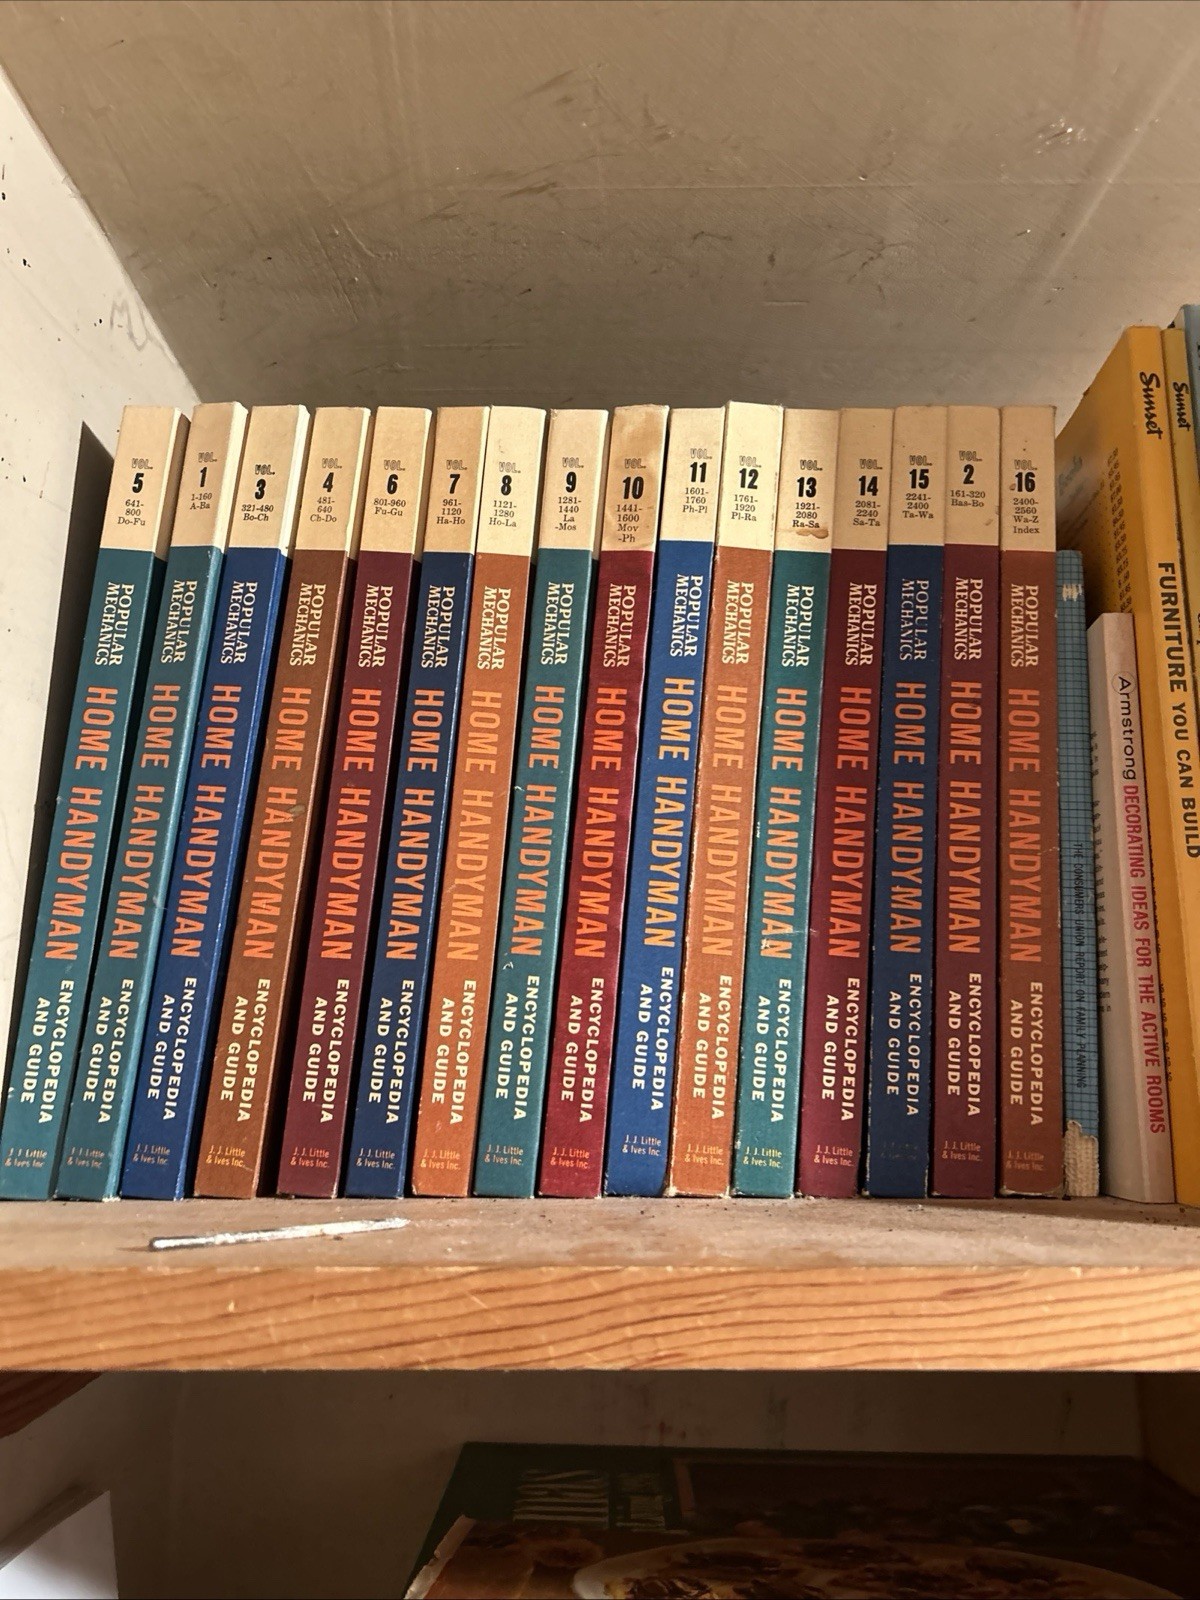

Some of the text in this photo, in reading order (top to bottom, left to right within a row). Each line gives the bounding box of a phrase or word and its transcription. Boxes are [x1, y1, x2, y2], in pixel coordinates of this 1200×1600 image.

[1139, 371, 1163, 439] Sunset
[1172, 381, 1191, 431] Sunset
[132, 458, 153, 469] VOL.
[198, 453, 217, 462] VOL.
[322, 458, 342, 468] VOL.
[562, 457, 584, 468] VOL.
[624, 458, 646, 469] VOL.
[690, 448, 712, 459] VOL.
[739, 456, 761, 468] VOL.
[859, 459, 882, 469] VOL.
[909, 455, 932, 466] VOL.
[959, 451, 982, 462] VOL.
[1014, 459, 1037, 470] VOL.
[255, 465, 275, 475] VOL.
[384, 460, 405, 471] VOL.
[446, 460, 467, 470] VOL.
[499, 462, 521, 473] VOL.
[690, 462, 707, 482] 11
[800, 460, 823, 471] VOL.
[963, 464, 974, 484] 2
[132, 473, 144, 493] 5
[200, 467, 207, 487] 1
[323, 472, 334, 492] 4
[387, 474, 398, 494] 6
[449, 474, 460, 494] 7
[501, 475, 512, 495] 8
[566, 472, 577, 492] 9
[623, 476, 644, 499] 10
[739, 468, 759, 489] 12
[797, 477, 817, 497] 13
[859, 476, 878, 496] 14
[909, 469, 929, 489] 15
[1015, 472, 1035, 492] 16
[255, 479, 266, 499] 3
[735, 504, 755, 512] 1920
[907, 502, 929, 510] 2400
[617, 514, 639, 522] 1600
[618, 524, 639, 532] Mov
[1013, 526, 1040, 534] Index
[95, 582, 120, 666] MECHANICS
[109, 584, 135, 665] POPULAR
[358, 585, 379, 667] MECHANICS
[371, 586, 392, 667] POPULAR
[670, 574, 689, 657] MECHANICS
[684, 576, 703, 656] POPULAR
[782, 584, 801, 667] MECHANICS
[795, 585, 814, 667] POPULAR
[954, 577, 970, 660] MECHANICS
[968, 579, 983, 661] POPULAR
[478, 587, 497, 670] MECHANICS
[491, 588, 511, 670] POPULAR
[1158, 562, 1200, 858] FURNITURE YOU CAN BUILD
[1118, 675, 1136, 780] Armstrong
[45, 686, 118, 960] HOME HANDYMAN
[575, 687, 627, 959] HOME HANDYMAN
[644, 678, 695, 947] HOME HANDYMAN
[760, 687, 807, 959] HOME HANDYMAN
[948, 681, 981, 953] HOME HANDYMAN
[320, 689, 381, 960] HOME HANDYMAN
[447, 691, 501, 960] HOME HANDYMAN
[1073, 843, 1083, 858] THE
[1073, 863, 1085, 914] CONSUMERS
[1075, 919, 1085, 947] UNION
[1123, 785, 1165, 1133] DECORATING IDEAS FOR THE ACTIVE ROOMS
[632, 984, 651, 1089] AND GUIDE
[650, 967, 673, 1110] ENCYCLOPEDIA
[948, 991, 962, 1096] AND GUIDE
[967, 973, 981, 1117] ENCYCLOPEDIA
[22, 998, 49, 1103] AND GUIDE
[38, 979, 74, 1123] ENCYCLOPEDIA
[302, 998, 327, 1102] AND GUIDE
[320, 979, 348, 1123] ENCYCLOPEDIA
[432, 999, 453, 1103] AND GUIDE
[450, 981, 475, 1124] ENCYCLOPEDIA
[752, 996, 769, 1101] AND GUIDE
[770, 979, 791, 1122] ENCYCLOPEDIA
[420, 1159, 460, 1170] & Ives Inc.
[440, 1150, 460, 1160] Little
